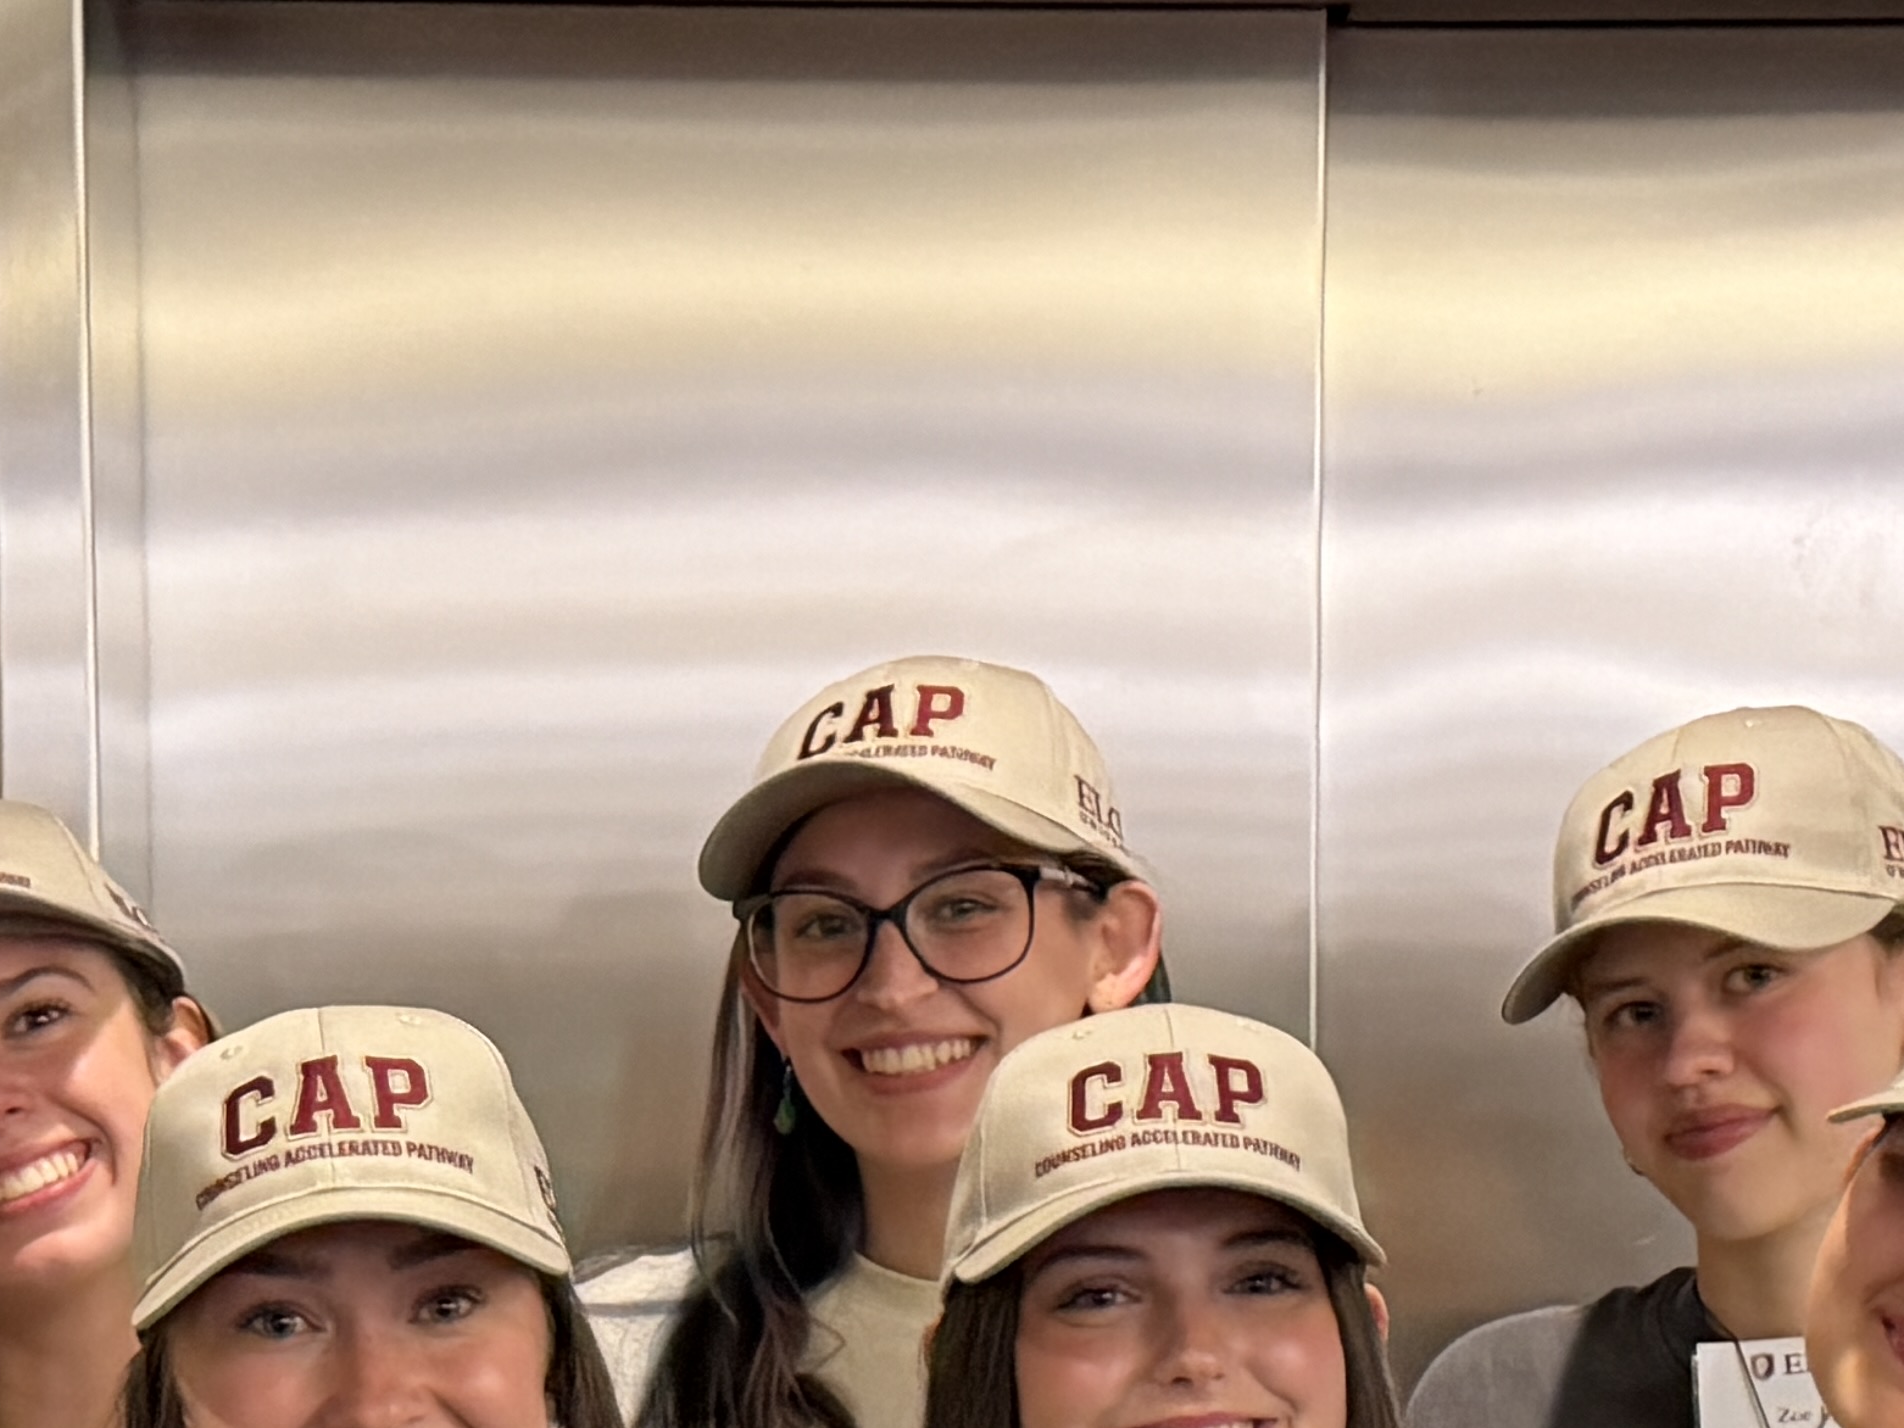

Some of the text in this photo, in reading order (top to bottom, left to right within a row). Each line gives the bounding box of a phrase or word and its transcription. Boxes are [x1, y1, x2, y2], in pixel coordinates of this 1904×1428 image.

[798, 684, 965, 760] CAP
[1593, 761, 1756, 866] CAP
[222, 1054, 430, 1157] CAP
[1068, 1051, 1265, 1133] CAP
[283, 1139, 403, 1169] ACCELERATED
[405, 1140, 475, 1175] PATHWAY
[1033, 1134, 1127, 1179] COUNSELING
[1129, 1129, 1241, 1155] ACCELERATED
